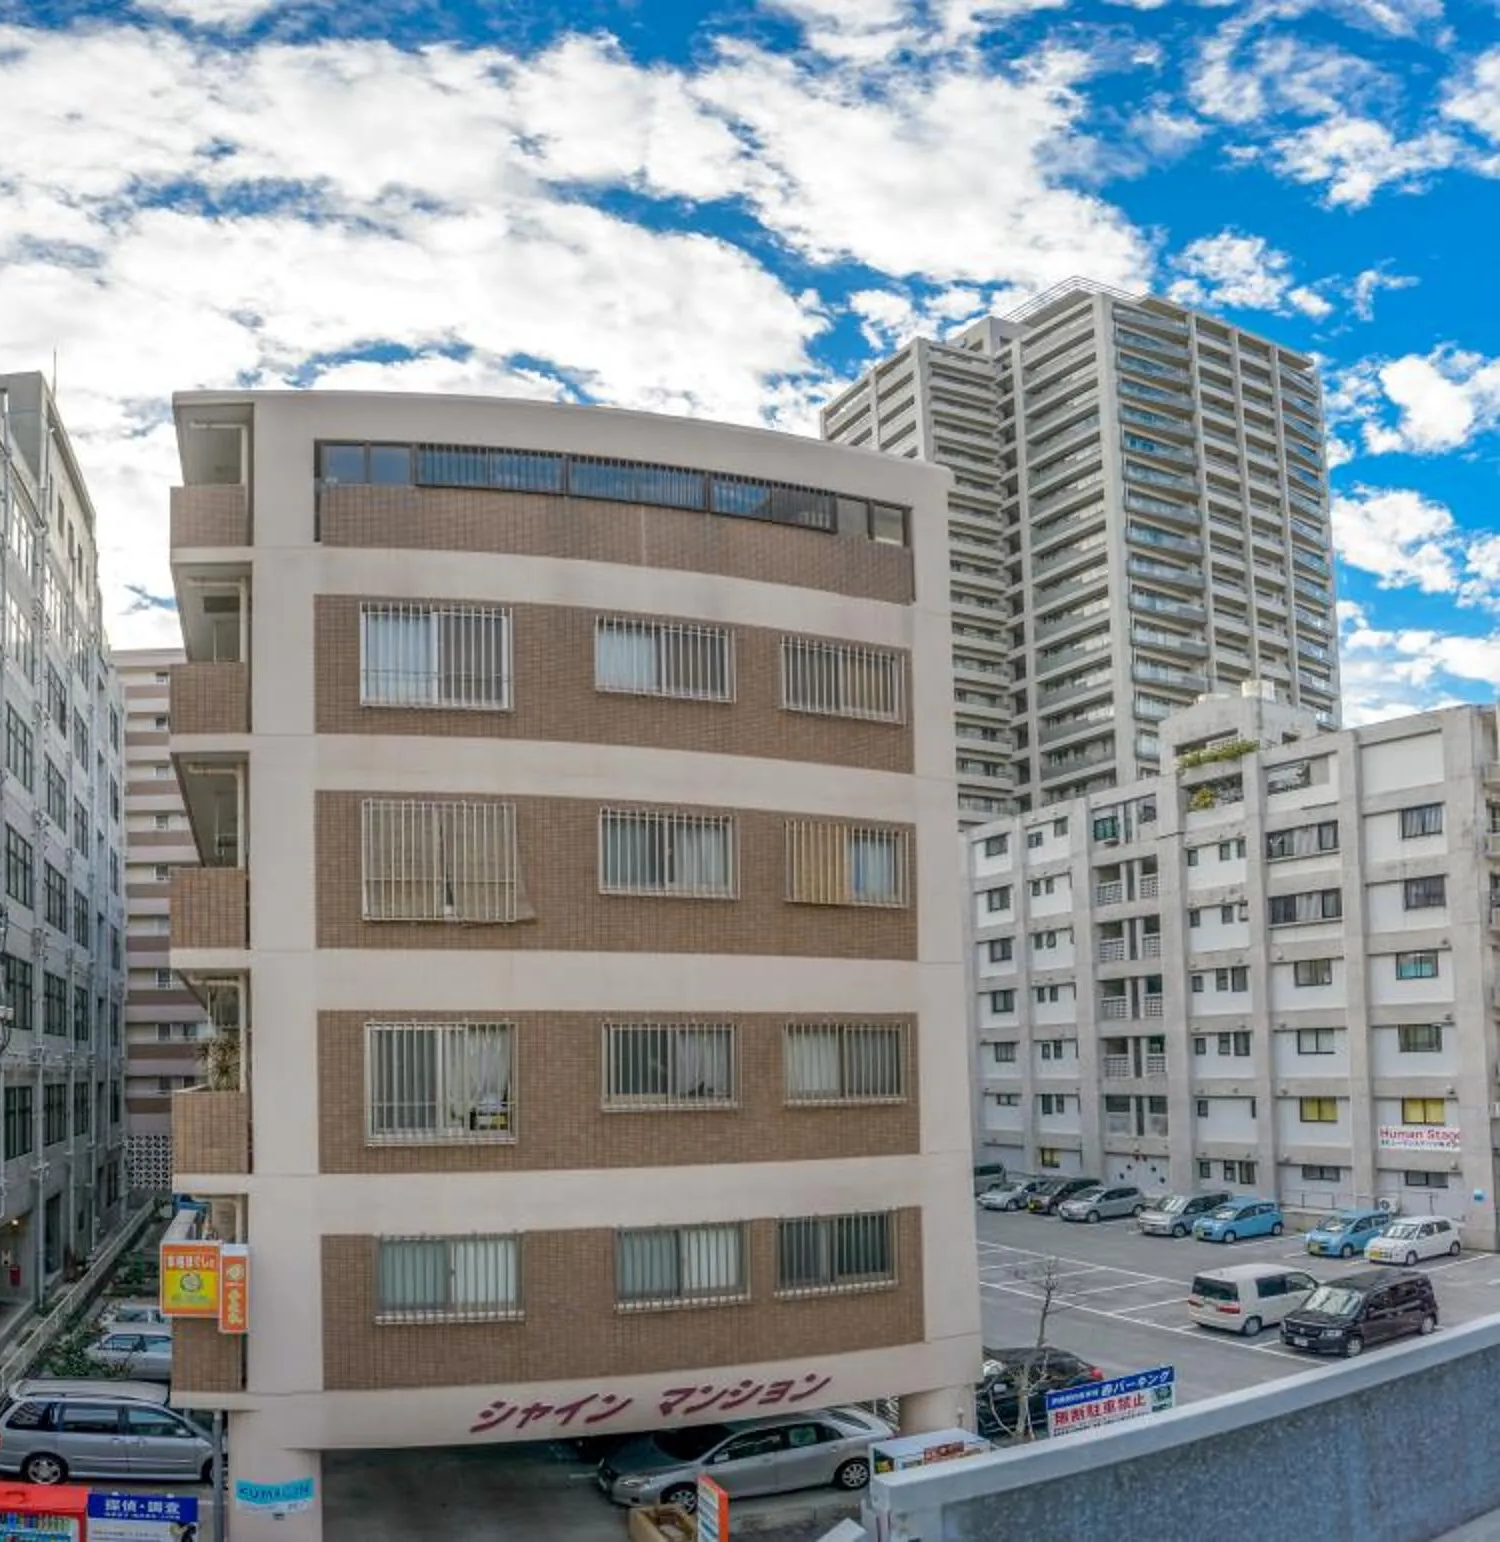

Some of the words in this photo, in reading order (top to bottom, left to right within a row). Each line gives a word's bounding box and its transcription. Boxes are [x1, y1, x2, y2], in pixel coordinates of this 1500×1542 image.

[1380, 1126, 1424, 1140] Human
[470, 1393, 634, 1433] シャイン
[659, 1373, 832, 1418] マンション
[1053, 1391, 1148, 1427] 無断駐車禁止
[104, 1497, 182, 1514] 探偵・調査
